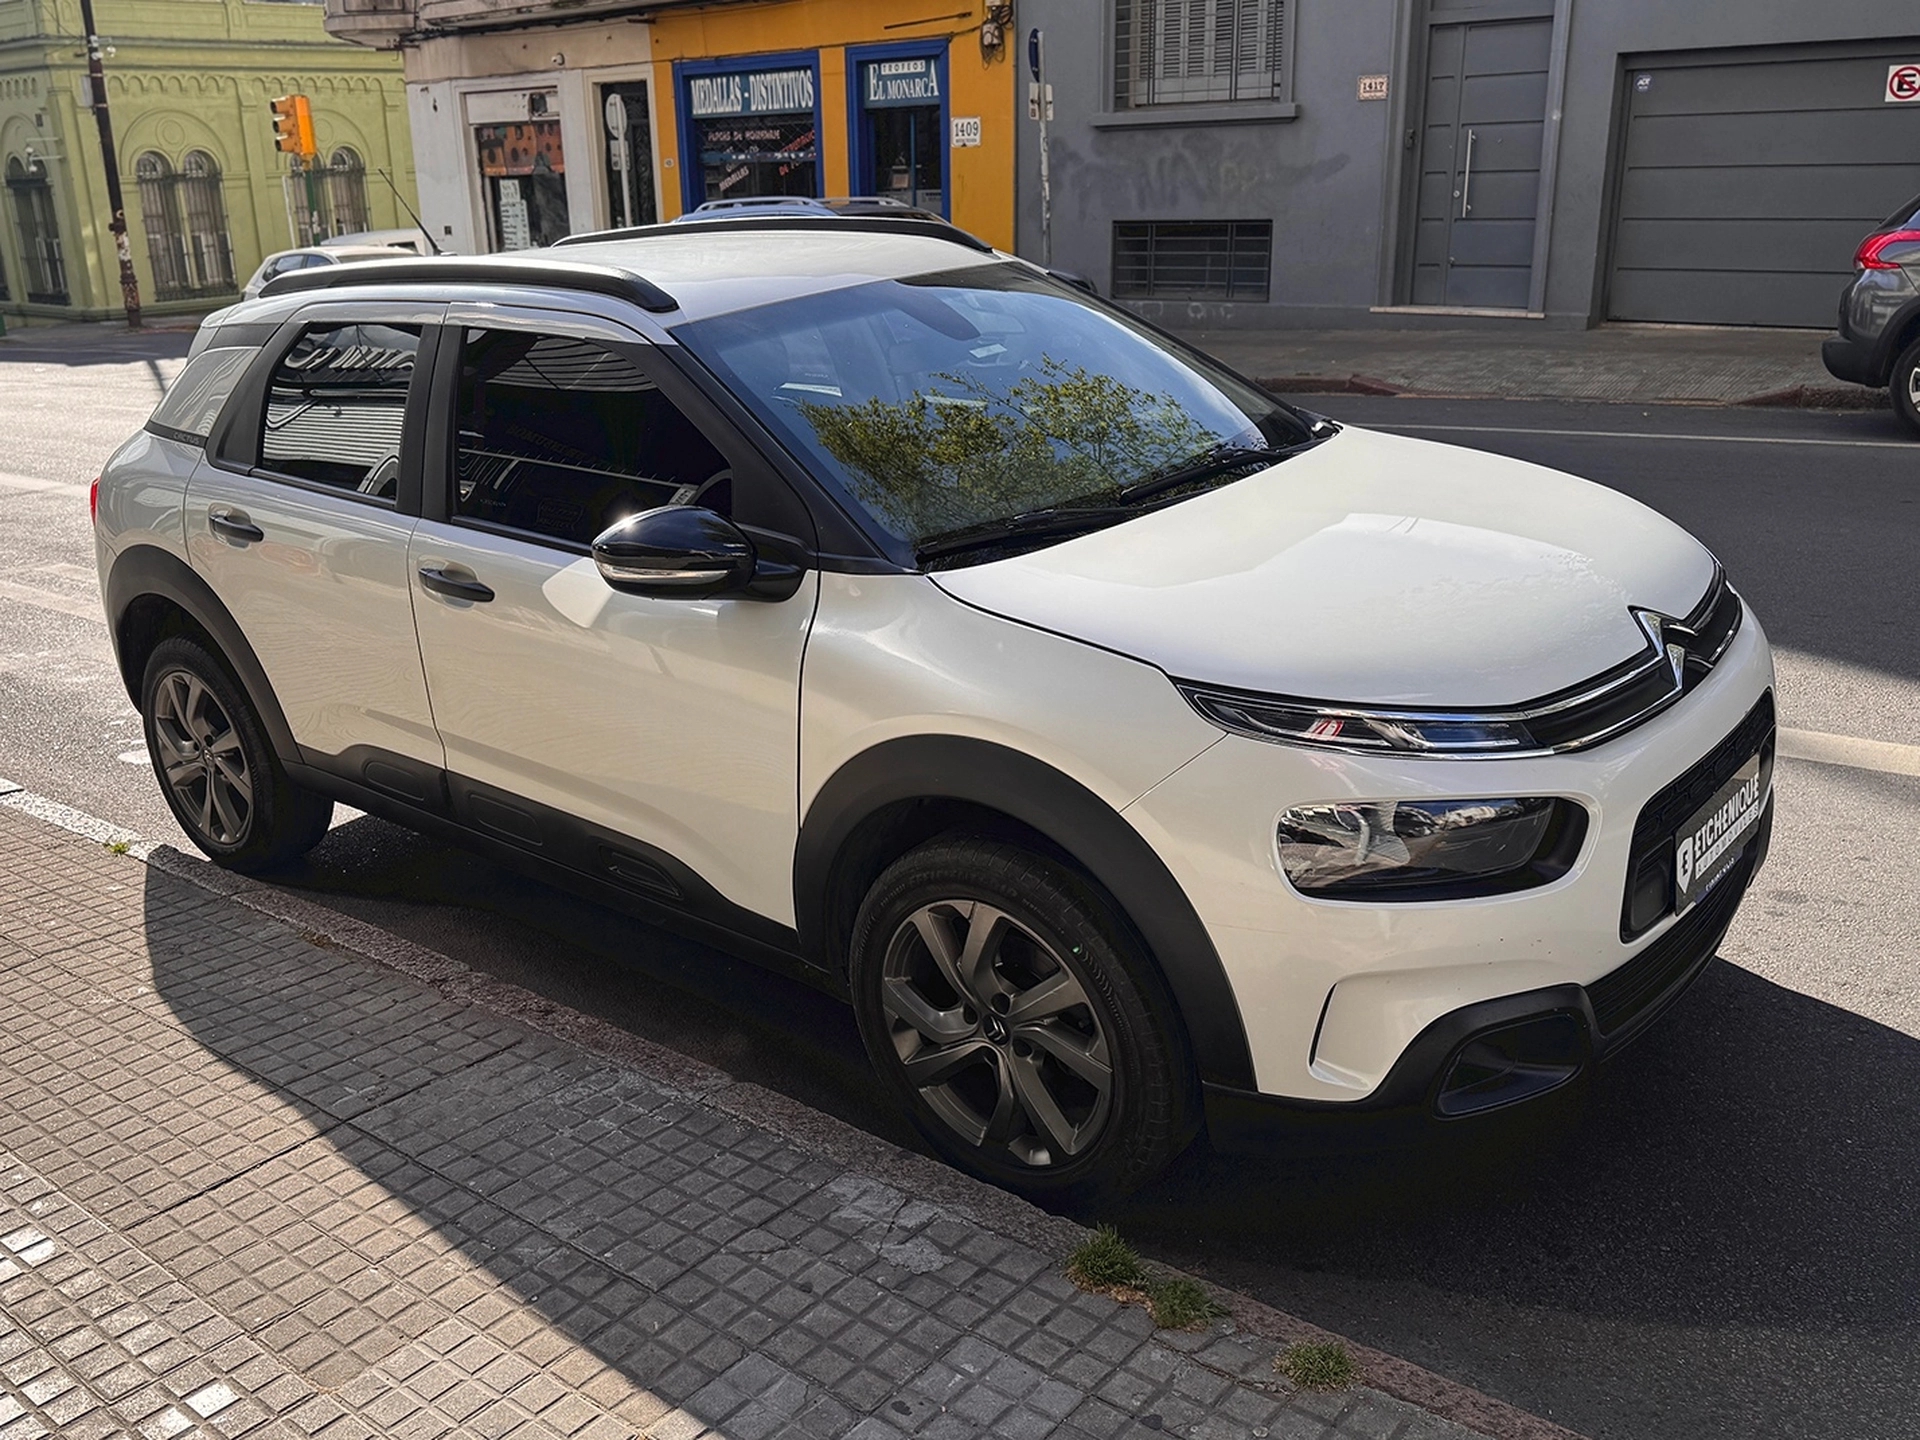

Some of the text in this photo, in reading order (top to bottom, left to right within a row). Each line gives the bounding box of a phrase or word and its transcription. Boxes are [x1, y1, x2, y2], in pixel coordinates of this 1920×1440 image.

[882, 61, 924, 73] TROFEOS
[868, 60, 939, 100] EL MONARCA
[1363, 81, 1384, 90] 1417
[690, 75, 742, 114] MEDALLAS
[749, 69, 814, 111] DISTINTIVOS
[955, 121, 979, 137] 1409
[719, 166, 749, 191] MEDALLAS
[173, 431, 200, 444] CACTUS
[1694, 772, 1760, 860] ETCHENIQUE
